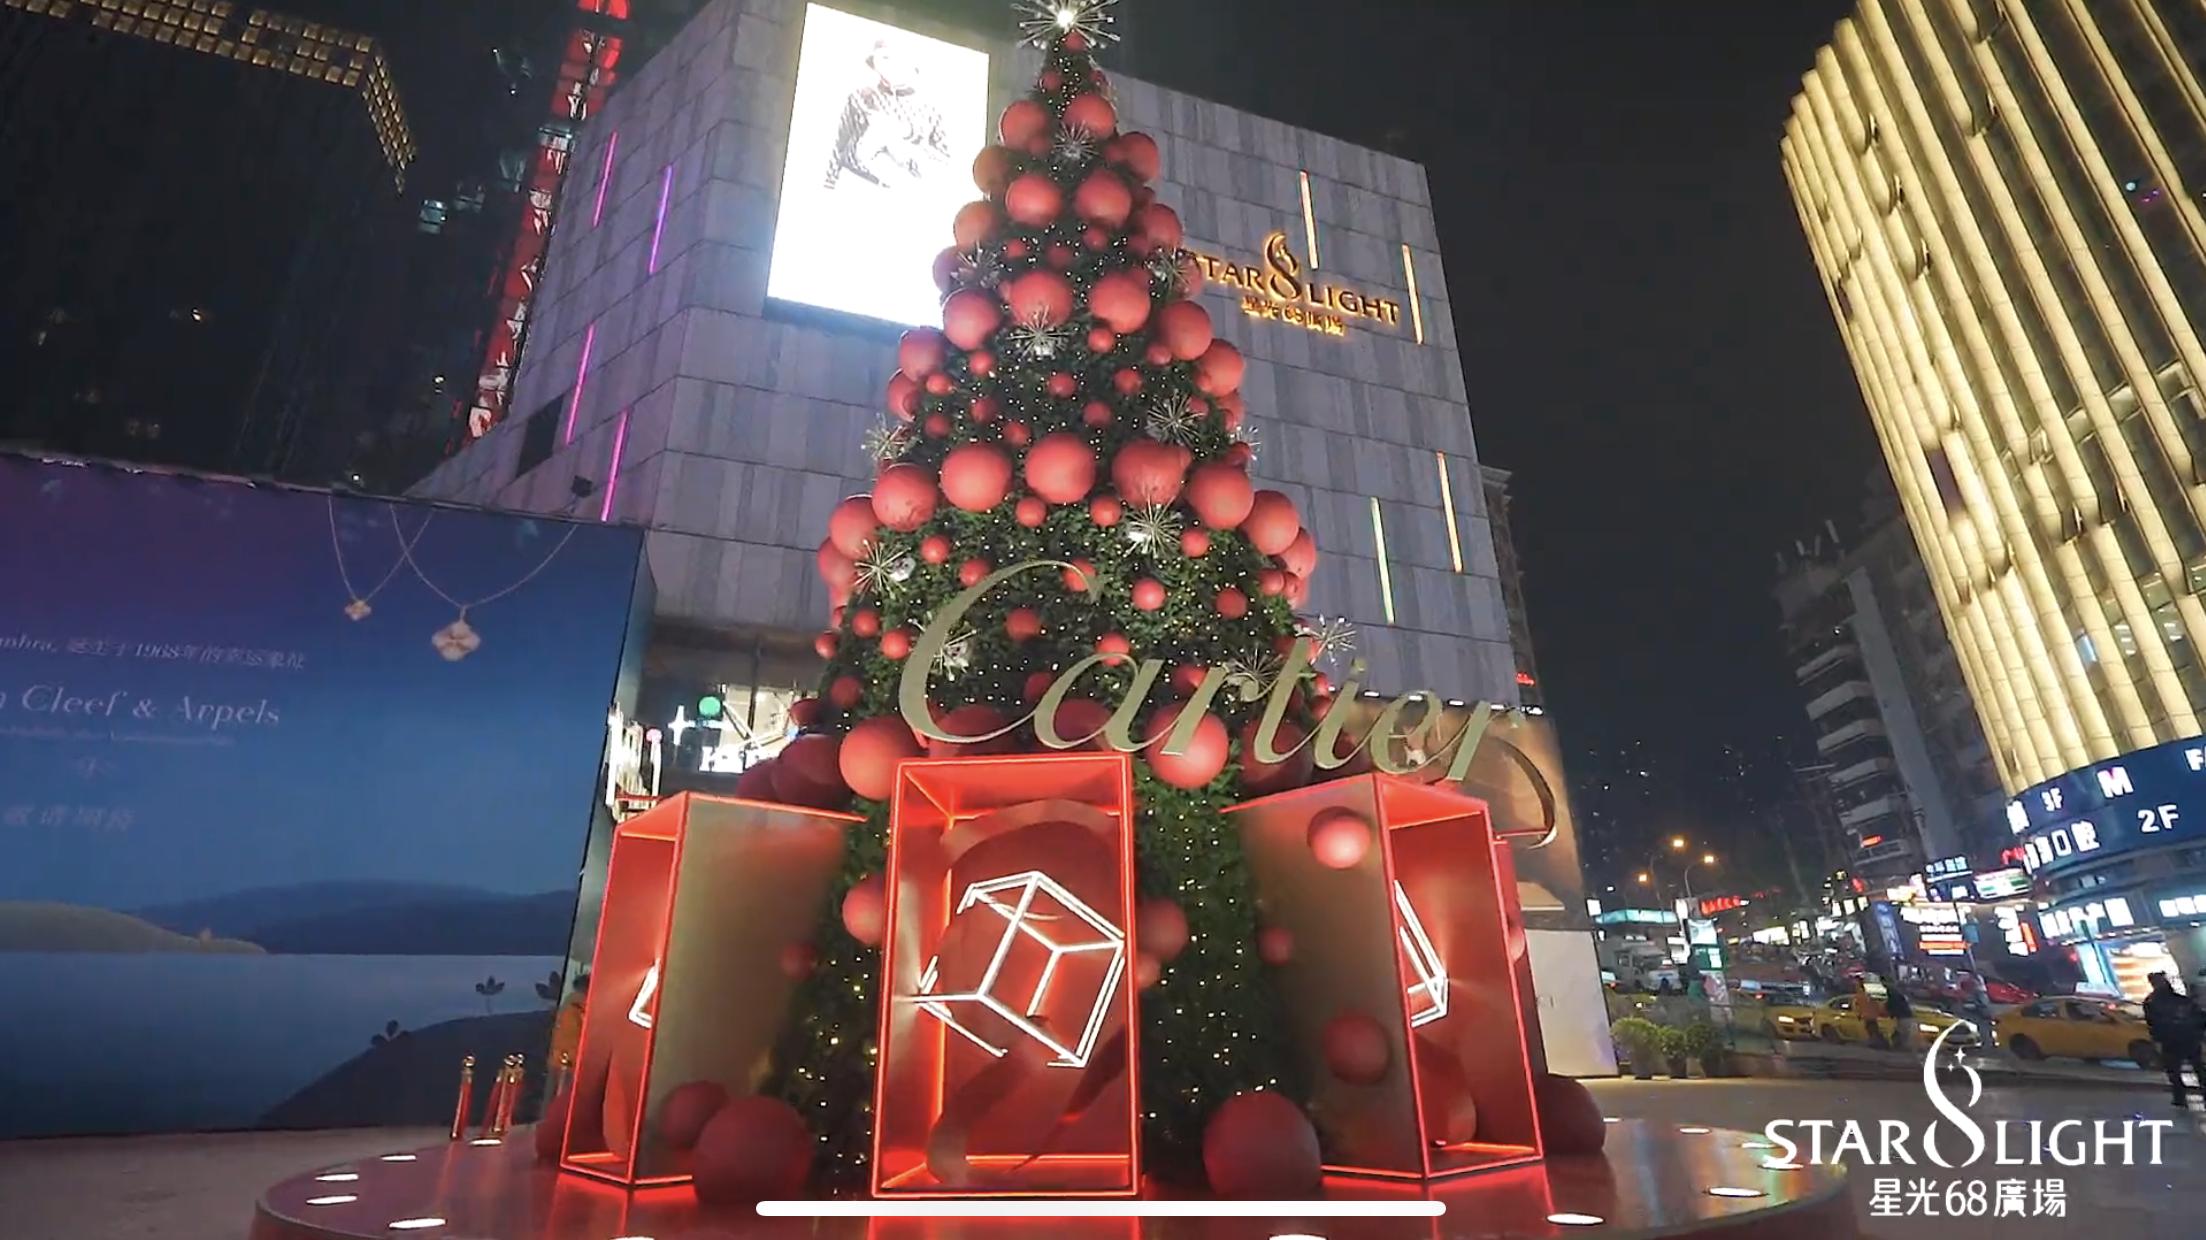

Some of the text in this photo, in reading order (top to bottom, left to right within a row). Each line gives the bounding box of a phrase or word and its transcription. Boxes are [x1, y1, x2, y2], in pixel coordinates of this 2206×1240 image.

[1195, 254, 1265, 293] TAR
[899, 559, 1526, 782] Cartier
[22, 684, 128, 716] Cleef
[132, 699, 156, 719] &
[178, 695, 279, 731] Arpels
[2137, 804, 2179, 833] 2F
